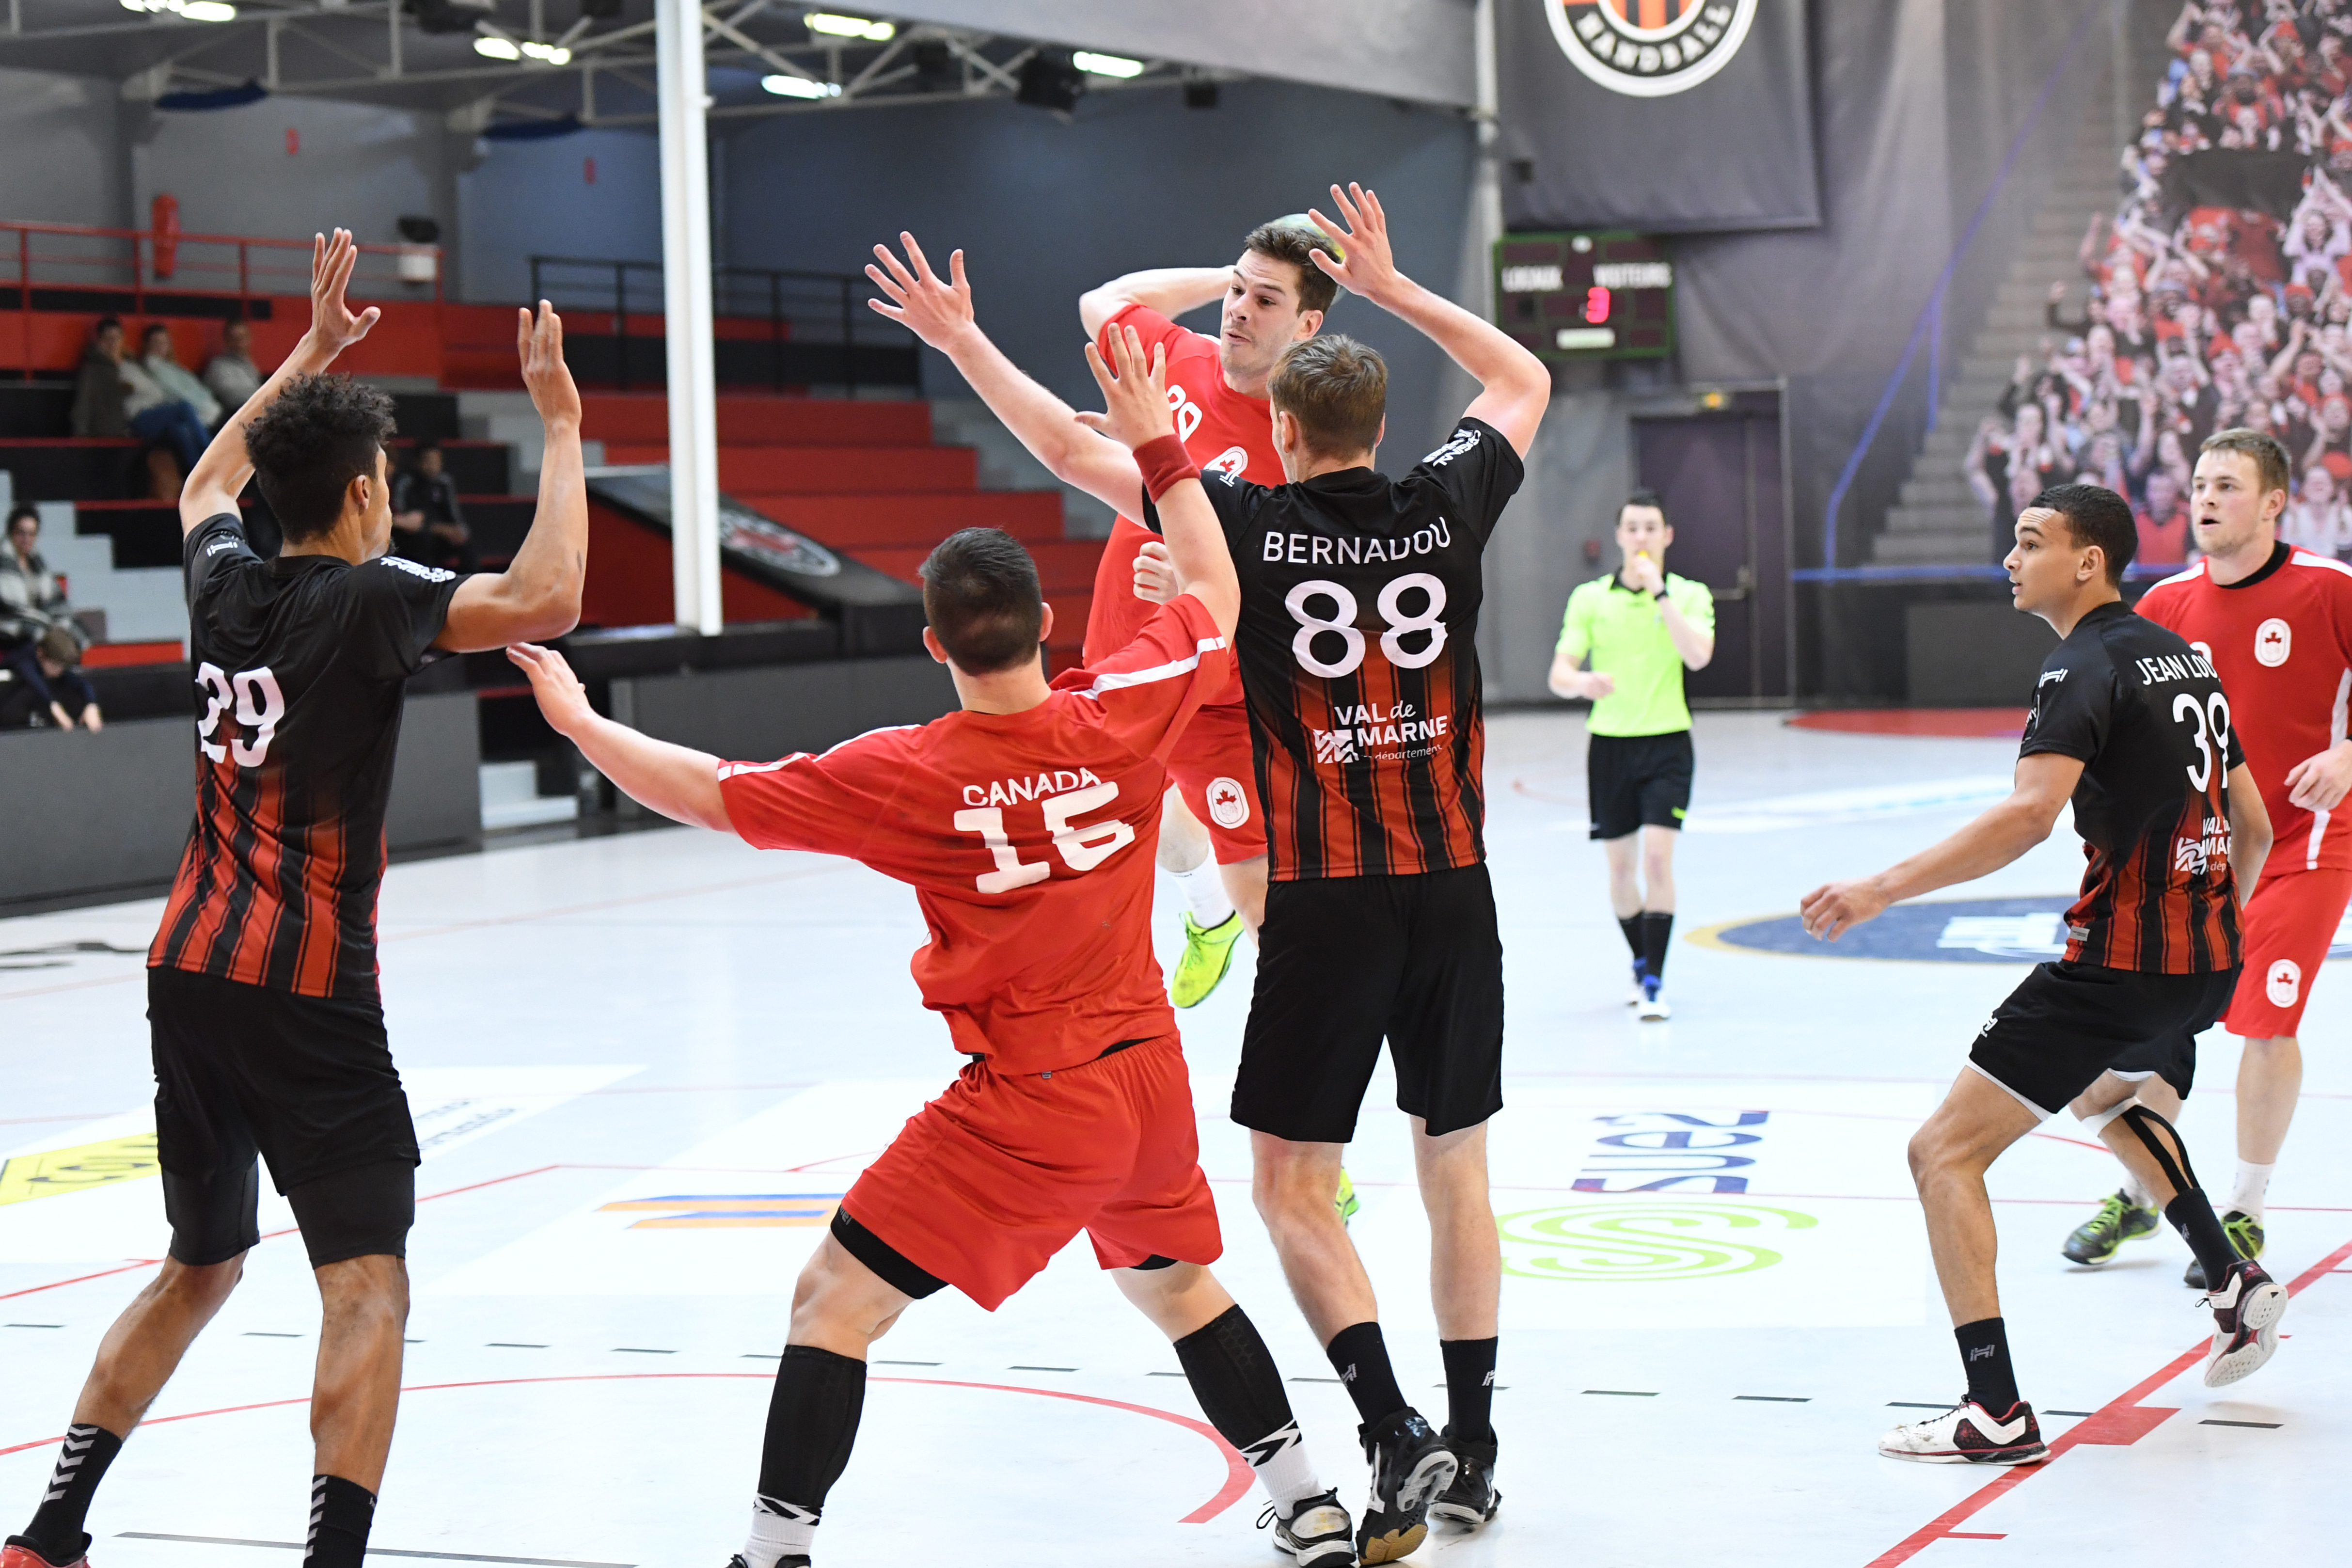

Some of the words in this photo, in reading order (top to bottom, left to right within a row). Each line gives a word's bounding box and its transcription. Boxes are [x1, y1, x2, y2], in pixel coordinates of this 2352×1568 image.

[1577, 4, 1731, 72] HANDBALL
[1263, 516, 1451, 564] BERNADOU
[1284, 572, 1448, 678] 88
[2135, 654, 2189, 685] JEAN
[2181, 654, 2221, 682] LOU
[195, 661, 285, 768] 29
[1334, 703, 1387, 725] VAL
[1390, 700, 1416, 719] de
[1357, 715, 1448, 747] MARNE
[2173, 692, 2230, 793] 39
[963, 767, 1102, 806] CANADA
[954, 781, 1135, 893] 16
[2203, 816, 2223, 836] VAL
